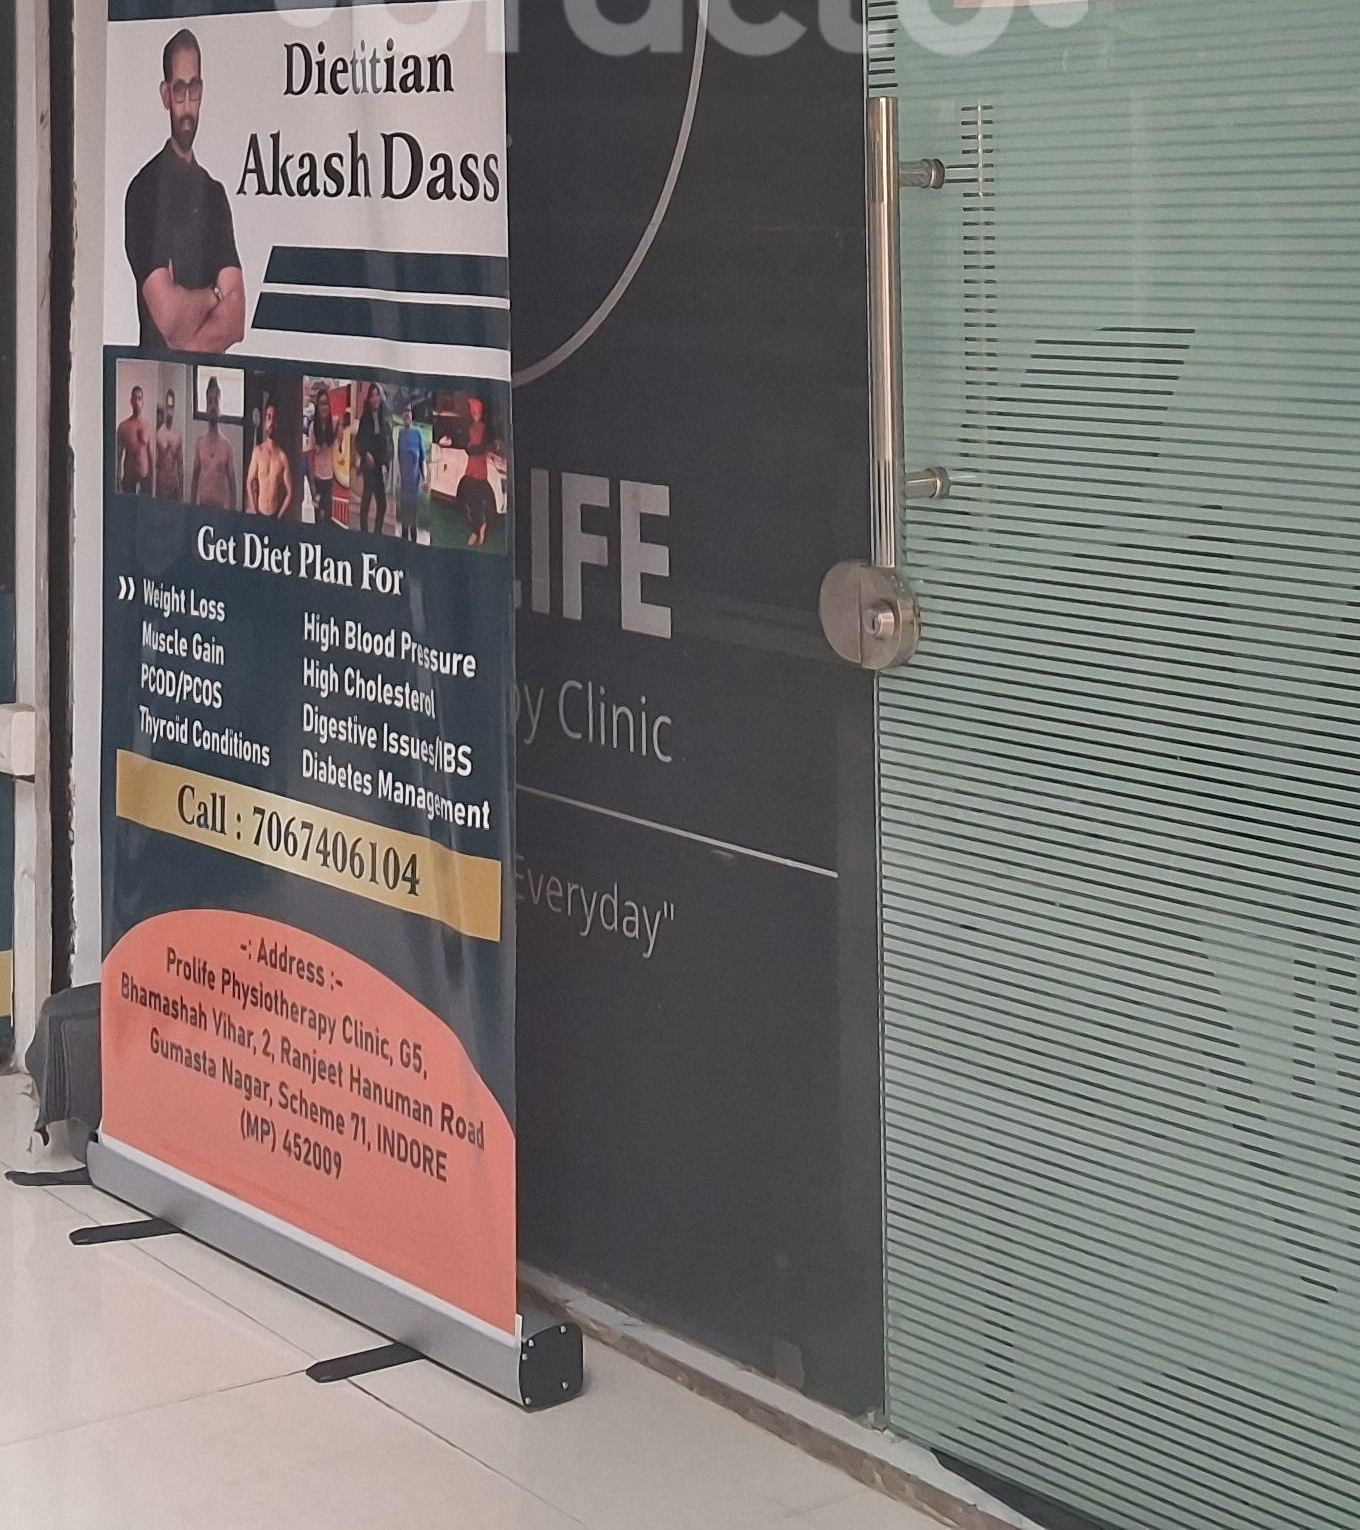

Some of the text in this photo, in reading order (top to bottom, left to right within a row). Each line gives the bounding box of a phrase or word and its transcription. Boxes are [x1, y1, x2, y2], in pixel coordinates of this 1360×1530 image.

[283, 37, 455, 97] Dietitian
[236, 129, 501, 203] Akash Dass
[197, 524, 405, 597] Get Diet Plan For
[513, 467, 673, 640] IFE
[142, 578, 226, 623] Weight Loss
[142, 620, 225, 666] Muscle Gain
[303, 611, 478, 679] High Blood Pressure
[141, 663, 223, 710] PCOD/PCOS
[302, 657, 436, 720] High Cholesterol
[558, 679, 673, 763] Clinic
[139, 705, 272, 768] Thyroid Conditions
[302, 702, 473, 778] Digestive Issues/IBS
[301, 748, 492, 831] Diabetes Management
[177, 784, 228, 837] Call
[251, 806, 421, 898] 7067406104
[256, 937, 326, 989] Address
[166, 946, 429, 1081] Prolife Physiotherapy Clinic, G5,
[120, 971, 487, 1151] Bhamashah Vihar, 2, Ranjeet Hanuman Road
[149, 1027, 448, 1183] Gumasta Nagar, Scheme 71, INDORE
[239, 1107, 343, 1180] (MP) 452009
